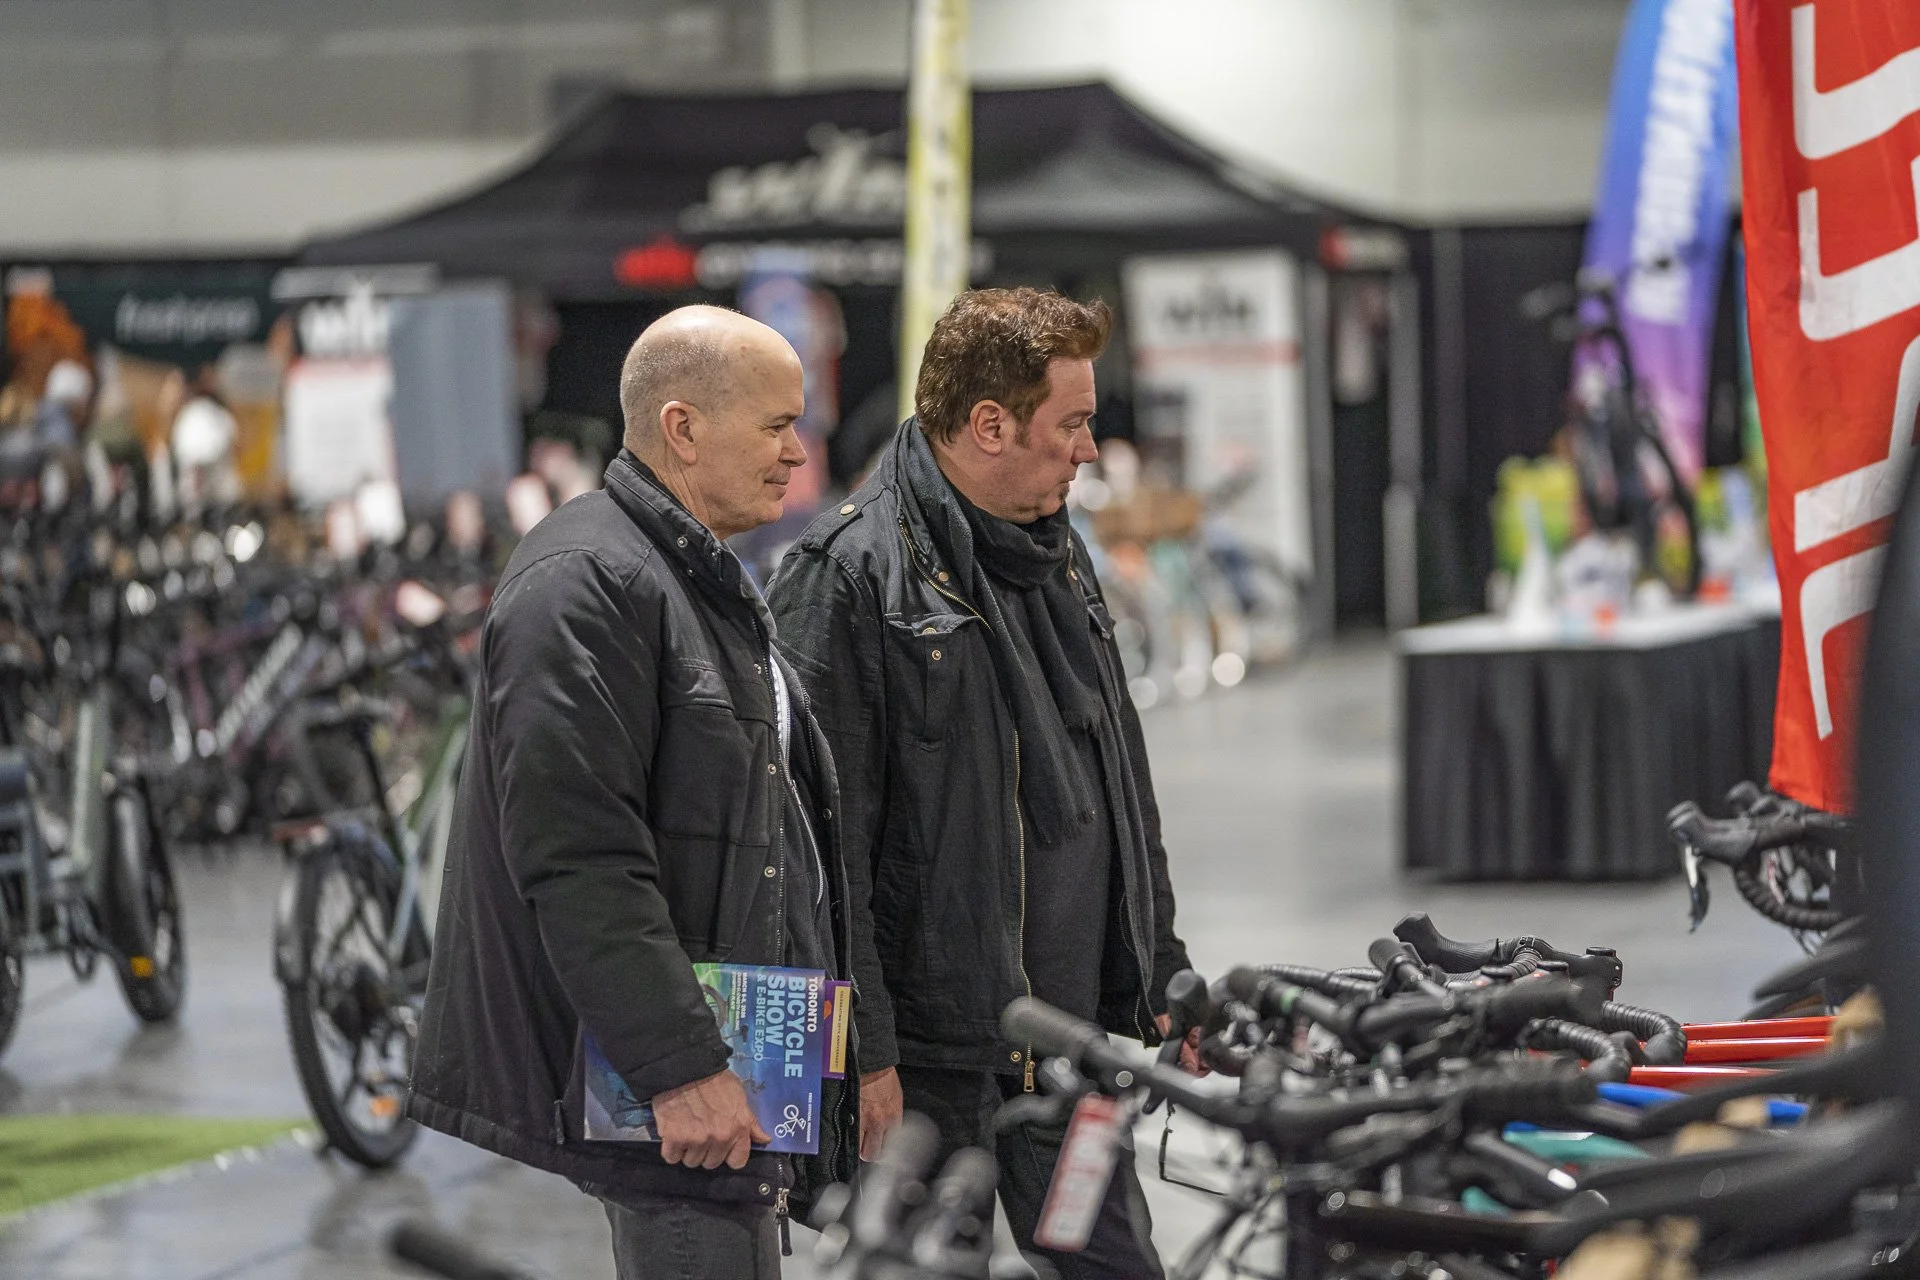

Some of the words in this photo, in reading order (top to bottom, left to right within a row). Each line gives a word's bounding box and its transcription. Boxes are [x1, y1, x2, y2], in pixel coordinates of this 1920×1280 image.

[756, 973, 767, 982] &
[755, 986, 766, 1026] E-BIKE
[766, 974, 786, 1047] SHOW
[784, 976, 806, 1078] BICYCLE
[807, 976, 818, 1033] TORONTO
[754, 1029, 765, 1061] EXPO
